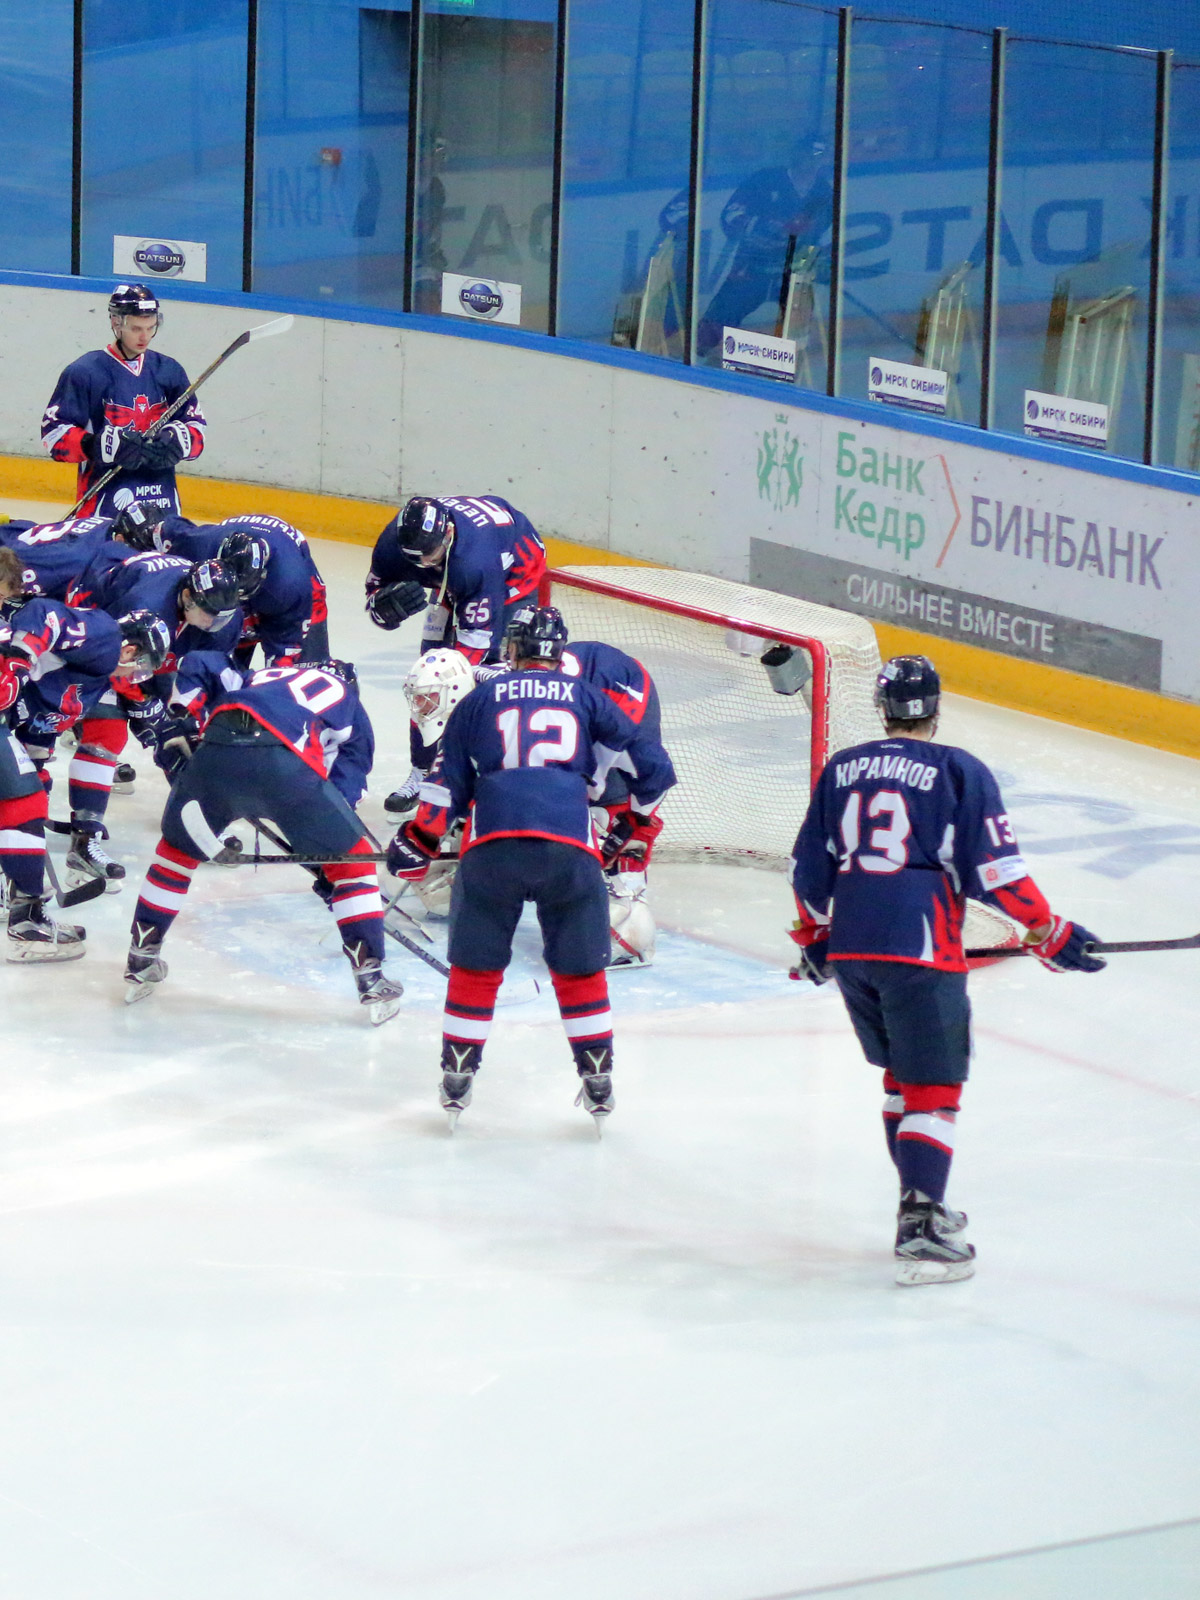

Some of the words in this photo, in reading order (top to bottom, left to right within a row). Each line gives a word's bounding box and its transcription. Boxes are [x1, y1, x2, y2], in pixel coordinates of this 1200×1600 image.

[139, 253, 180, 263] DATSUN
[463, 292, 499, 305] DATSUN
[762, 347, 794, 364] СИБИРИ
[885, 373, 908, 388] МРСК
[911, 378, 945, 395] СИБИРИ
[1042, 406, 1066, 421] МРСК
[1069, 412, 1106, 430] СИБИРИ
[836, 431, 926, 496] Банк
[136, 485, 162, 496] МРСК
[834, 485, 926, 560] Кедр
[970, 495, 1168, 591] БИНБАНК
[465, 598, 490, 623] 55
[846, 573, 952, 628] СИЛЬНЕЕ
[959, 601, 1055, 654] ВМЕСТЕ
[539, 640, 553, 657] 12
[495, 678, 575, 702] РЕПЬЯХ
[907, 699, 924, 716] 13
[496, 707, 579, 769] 12
[835, 755, 938, 791] КАРАМНОВ
[837, 789, 912, 875] 13
[984, 812, 1017, 847] 13
